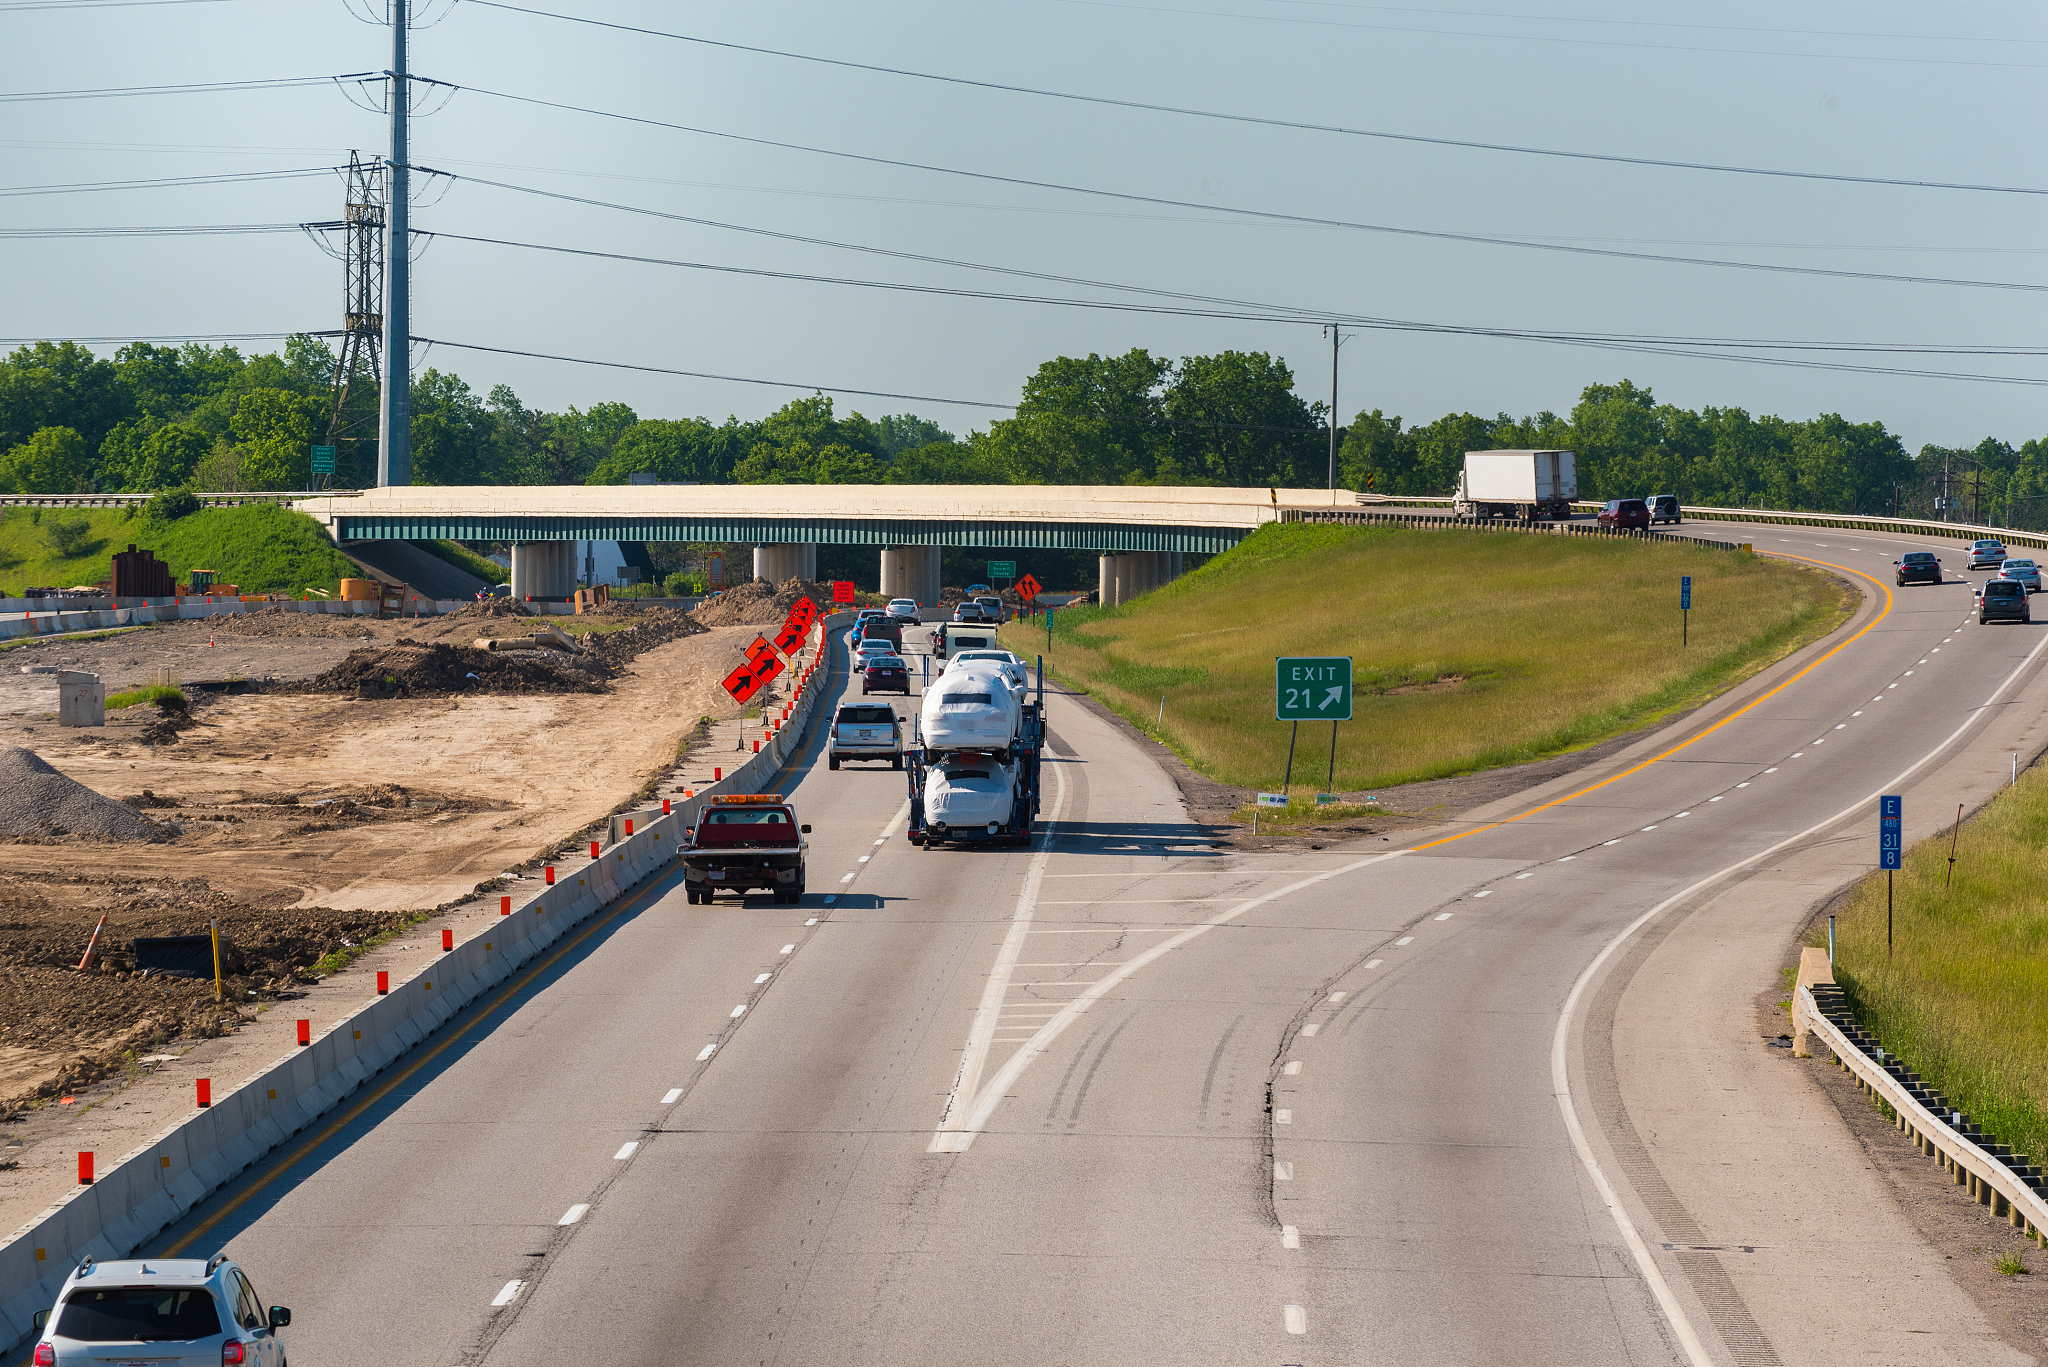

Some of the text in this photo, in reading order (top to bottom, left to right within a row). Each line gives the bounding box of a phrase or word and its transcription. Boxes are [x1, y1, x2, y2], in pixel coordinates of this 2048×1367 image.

[1292, 667, 1336, 681] EXIT
[79, 689, 88, 698] 27
[1285, 688, 1310, 709] 21
[1887, 800, 1895, 814] E
[1884, 819, 1897, 828] 480
[1883, 833, 1897, 847] 31
[1886, 851, 1895, 865] 8
